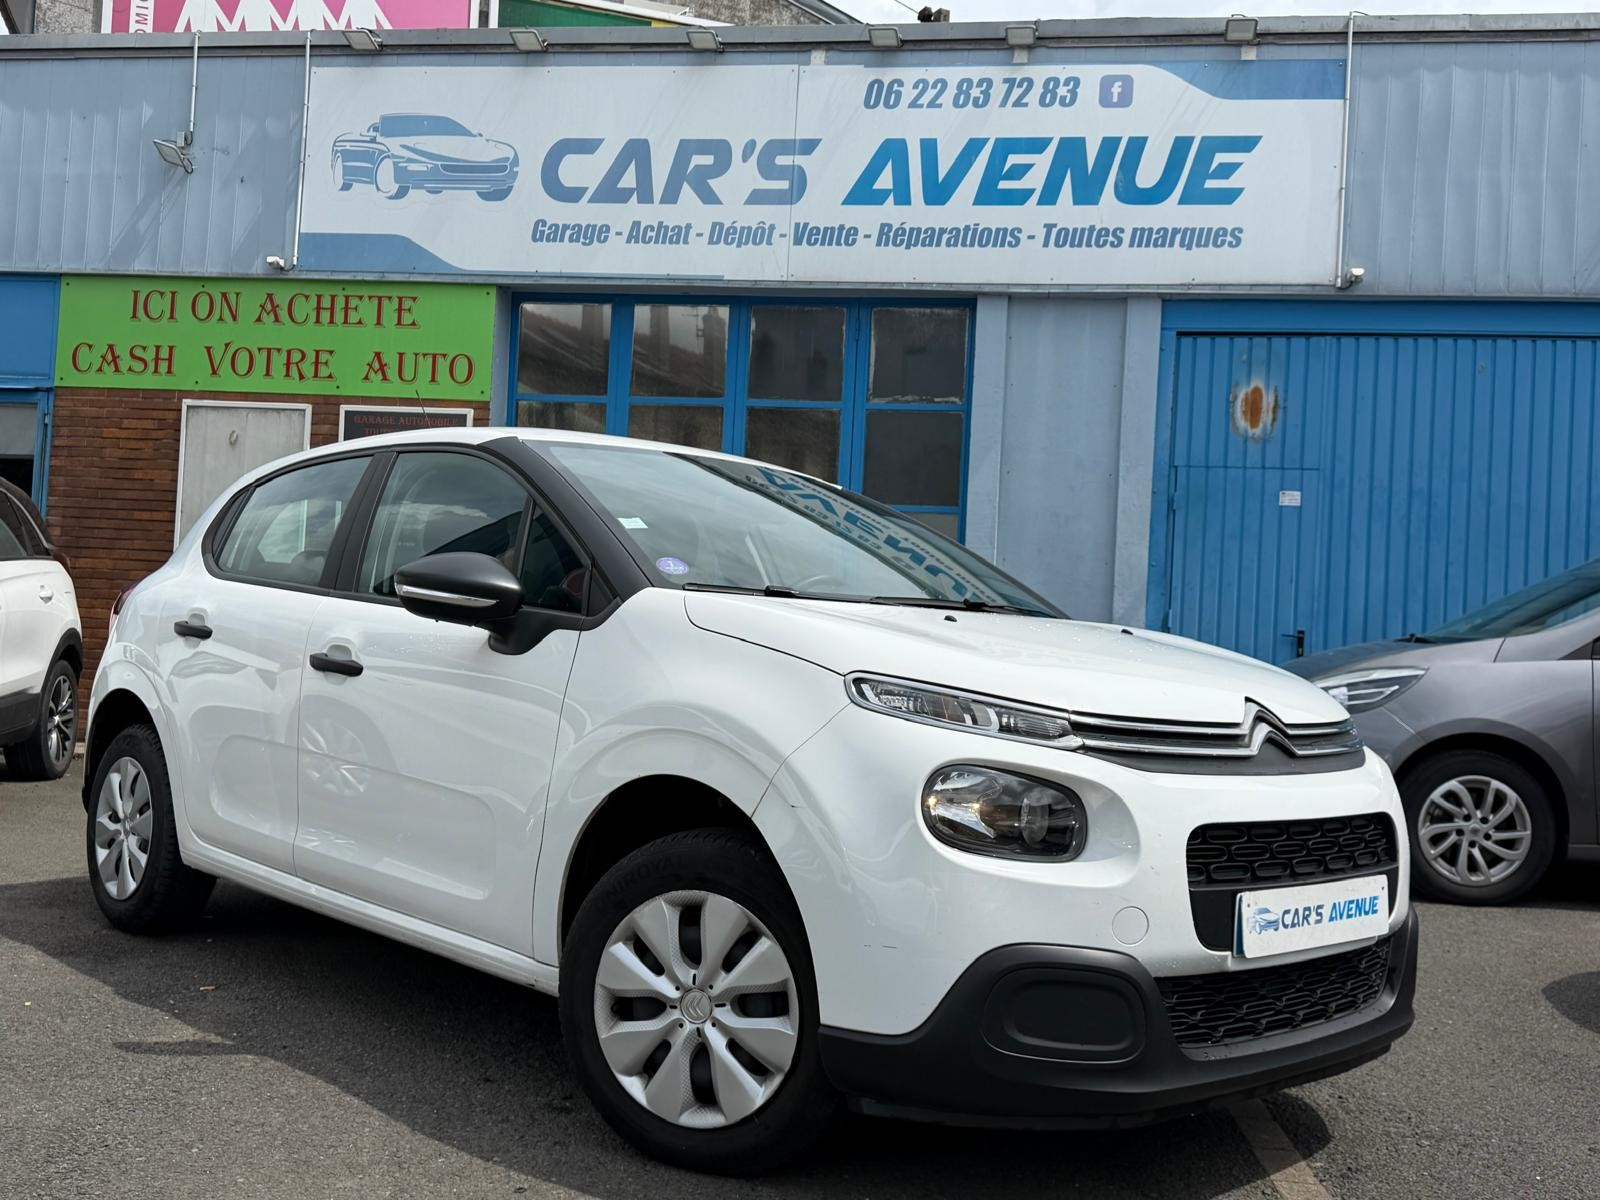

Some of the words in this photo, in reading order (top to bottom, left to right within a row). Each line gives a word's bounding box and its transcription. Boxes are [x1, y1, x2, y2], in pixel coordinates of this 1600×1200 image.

[864, 79, 904, 109] 06
[908, 78, 948, 109] 22
[951, 78, 993, 108] 83
[999, 77, 1034, 108] 72
[1039, 76, 1080, 107] 83
[541, 137, 822, 206] CAR'S
[841, 135, 1263, 206] AVENUE
[531, 218, 610, 246] Garage
[626, 220, 693, 246] Achat
[708, 220, 776, 248] Dépôt
[793, 221, 859, 247] Vente
[876, 222, 1022, 250] Réparations
[1042, 223, 1125, 249] Toutes
[1128, 226, 1244, 251] marques
[130, 290, 179, 322] ICI
[190, 291, 241, 324] ON
[253, 292, 421, 328] ACHETE
[71, 342, 177, 376] CASH
[204, 341, 337, 382] VOTRE
[361, 351, 476, 386] AUTO
[354, 416, 396, 425] GARAGE
[399, 417, 457, 427] AUTOMOBILE
[1281, 904, 1325, 929] CAR'S
[1328, 895, 1380, 923] AVENUE
